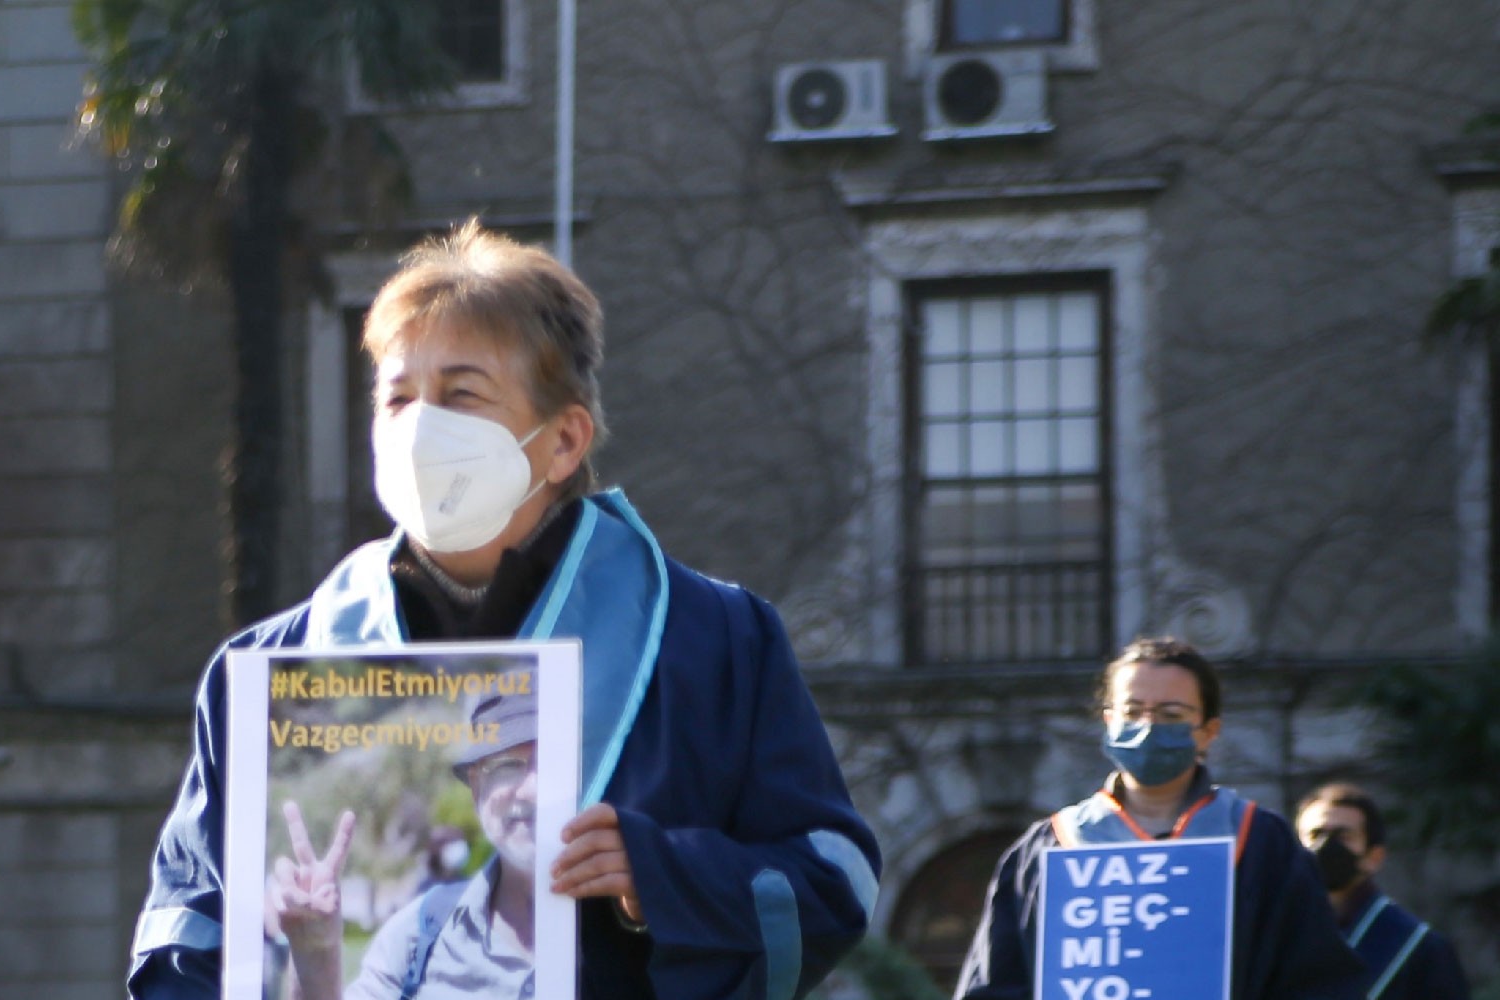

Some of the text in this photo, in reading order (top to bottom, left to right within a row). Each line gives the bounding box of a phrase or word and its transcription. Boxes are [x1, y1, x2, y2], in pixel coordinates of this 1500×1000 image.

[270, 668, 531, 702] #KabulEtmiyoruz
[270, 718, 500, 753] Vazgeçmiyoruz
[1064, 853, 1189, 888] VAZ-
[1062, 893, 1190, 930] GEÇ-
[1061, 927, 1143, 968] Mİ-
